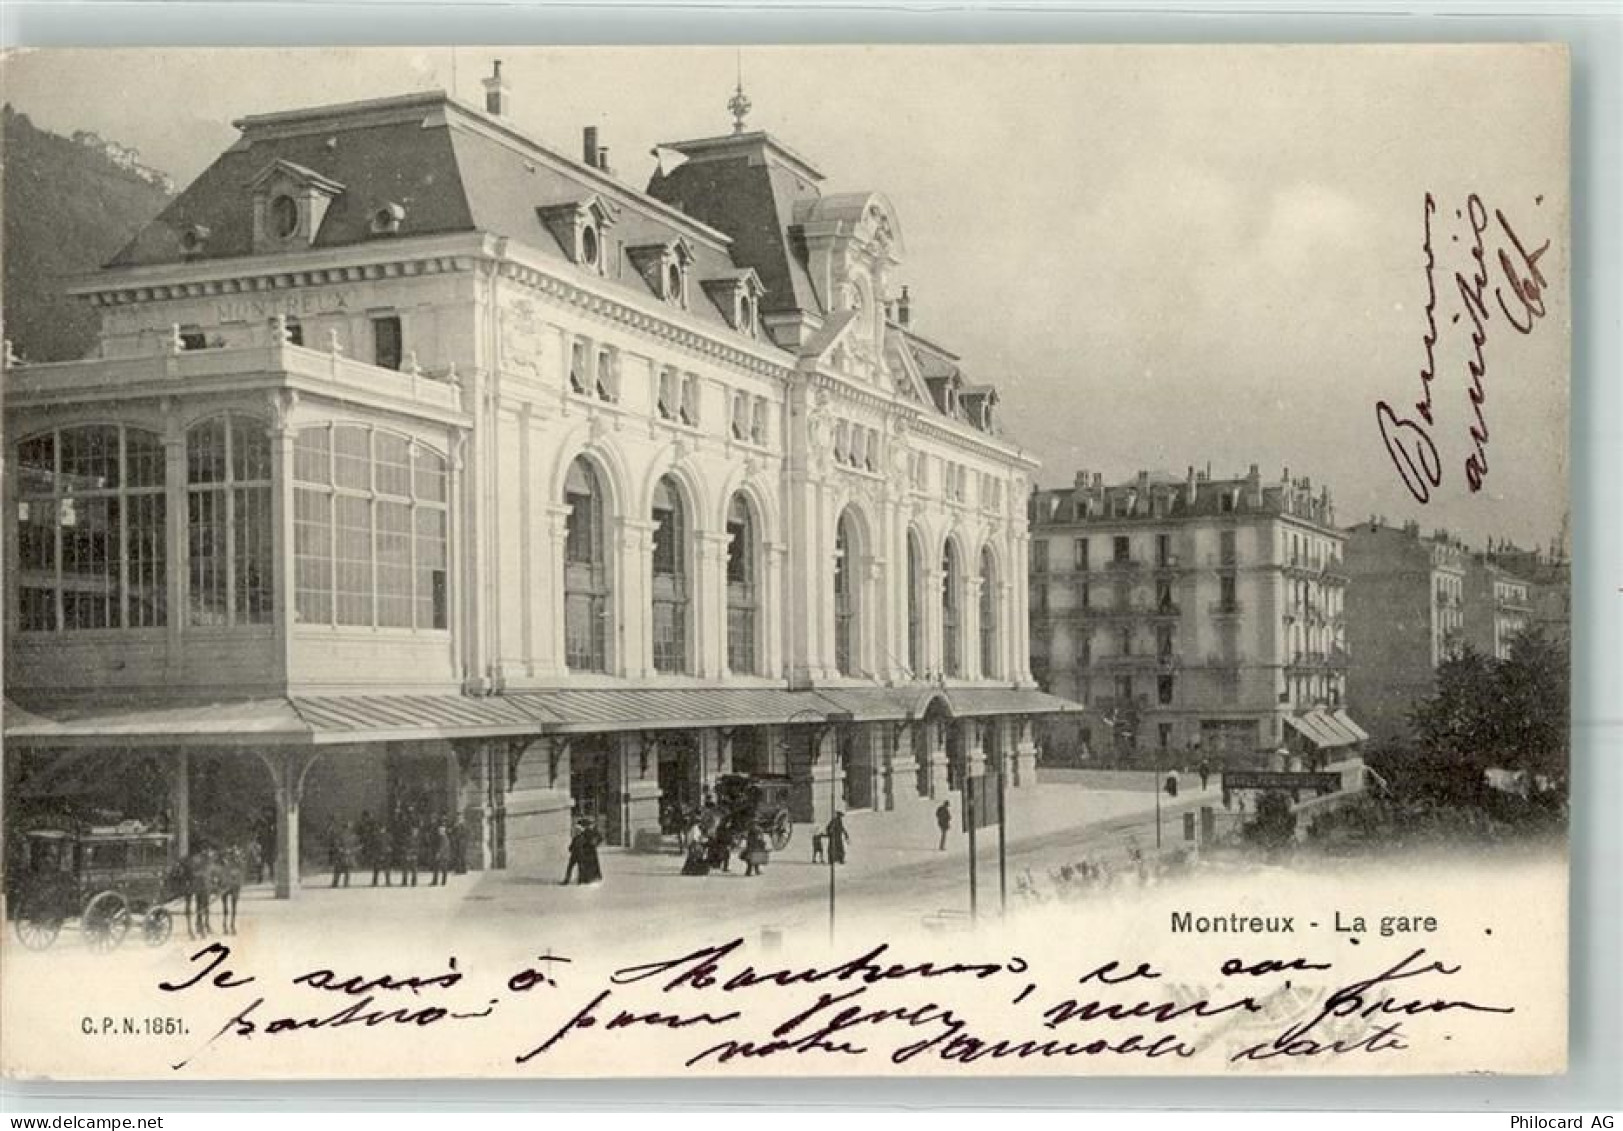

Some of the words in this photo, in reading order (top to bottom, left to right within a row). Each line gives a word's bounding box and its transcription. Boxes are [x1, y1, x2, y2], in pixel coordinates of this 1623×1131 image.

[1171, 910, 1296, 933] Montreux
[1334, 910, 1367, 933] La
[1379, 914, 1439, 937] gare
[158, 942, 256, 992] Je
